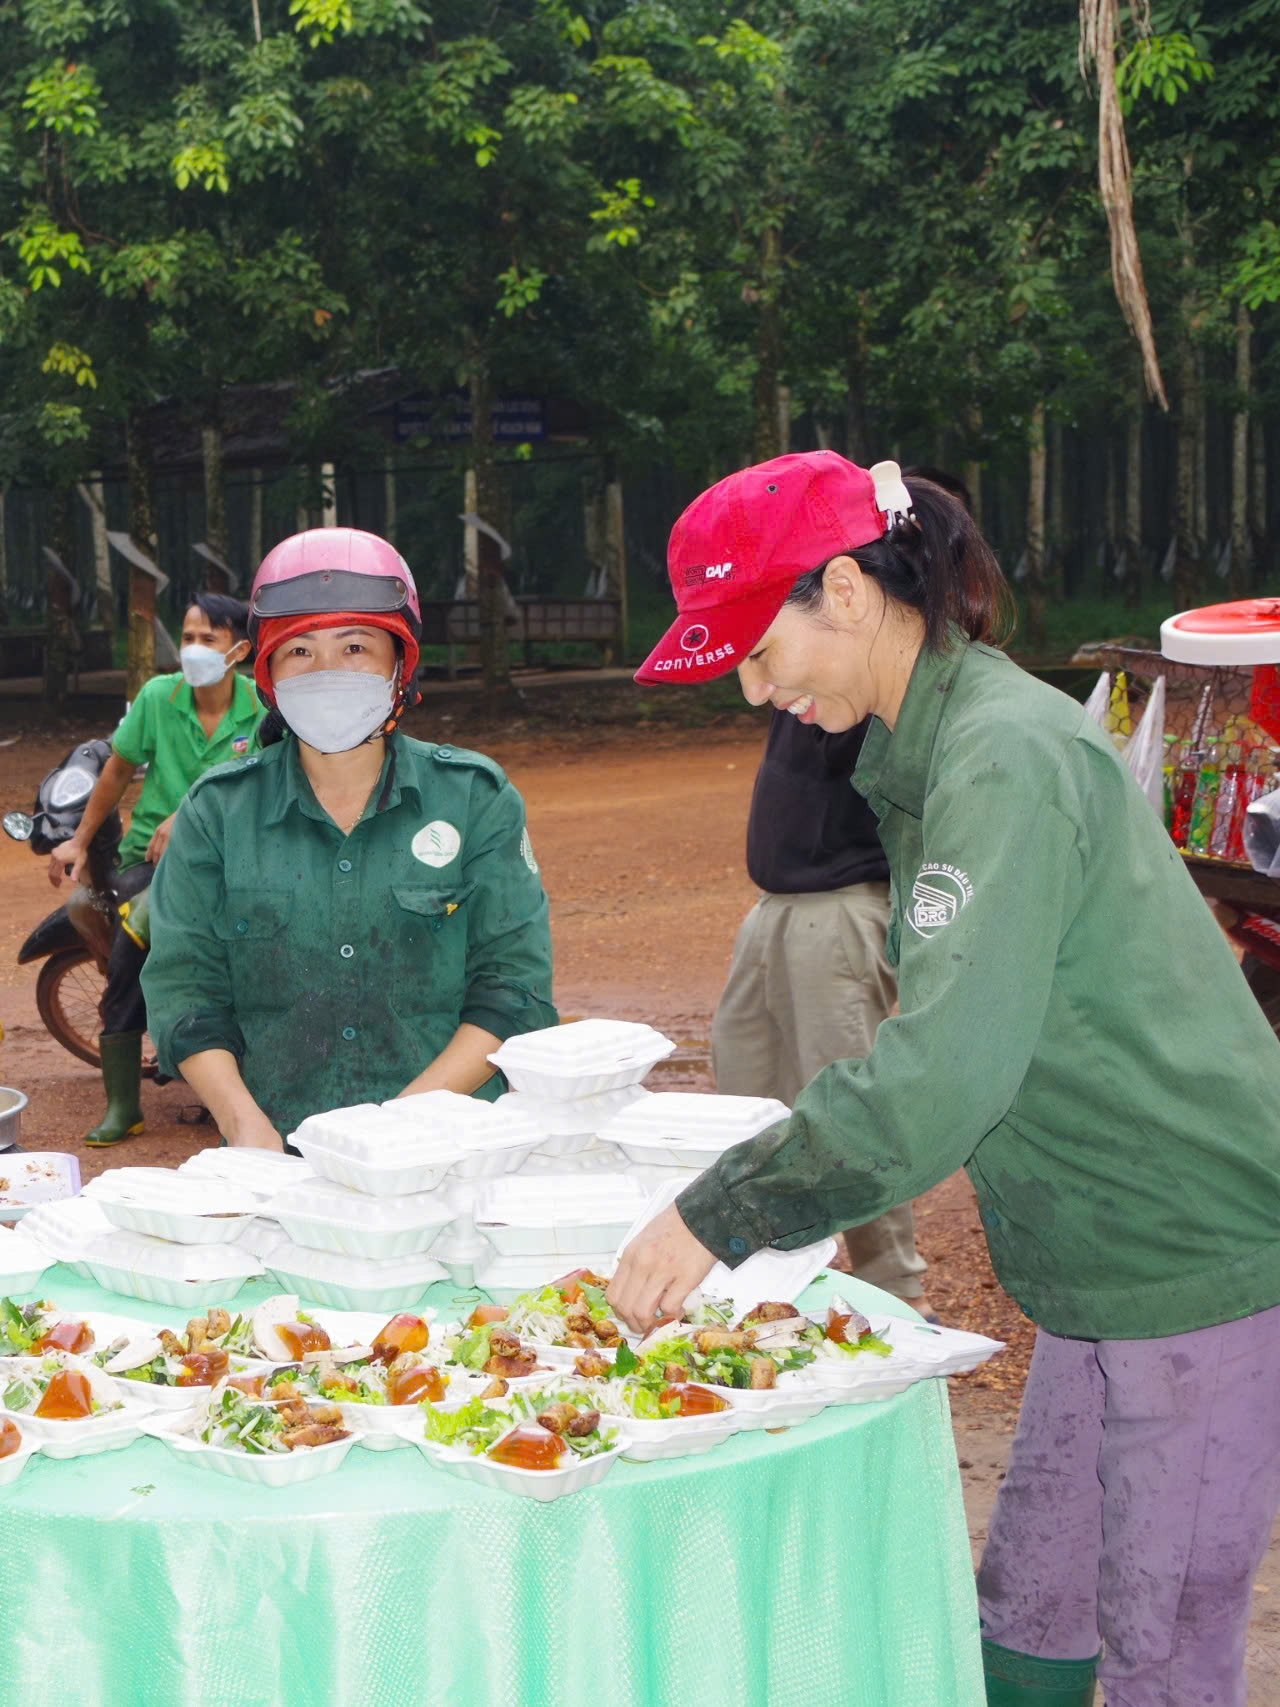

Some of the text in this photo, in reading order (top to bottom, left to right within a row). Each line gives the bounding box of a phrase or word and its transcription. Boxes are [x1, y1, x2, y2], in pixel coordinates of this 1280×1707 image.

[654, 643, 736, 671] CONVERSE
[922, 863, 939, 871] CAO
[918, 911, 947, 922] DRC
